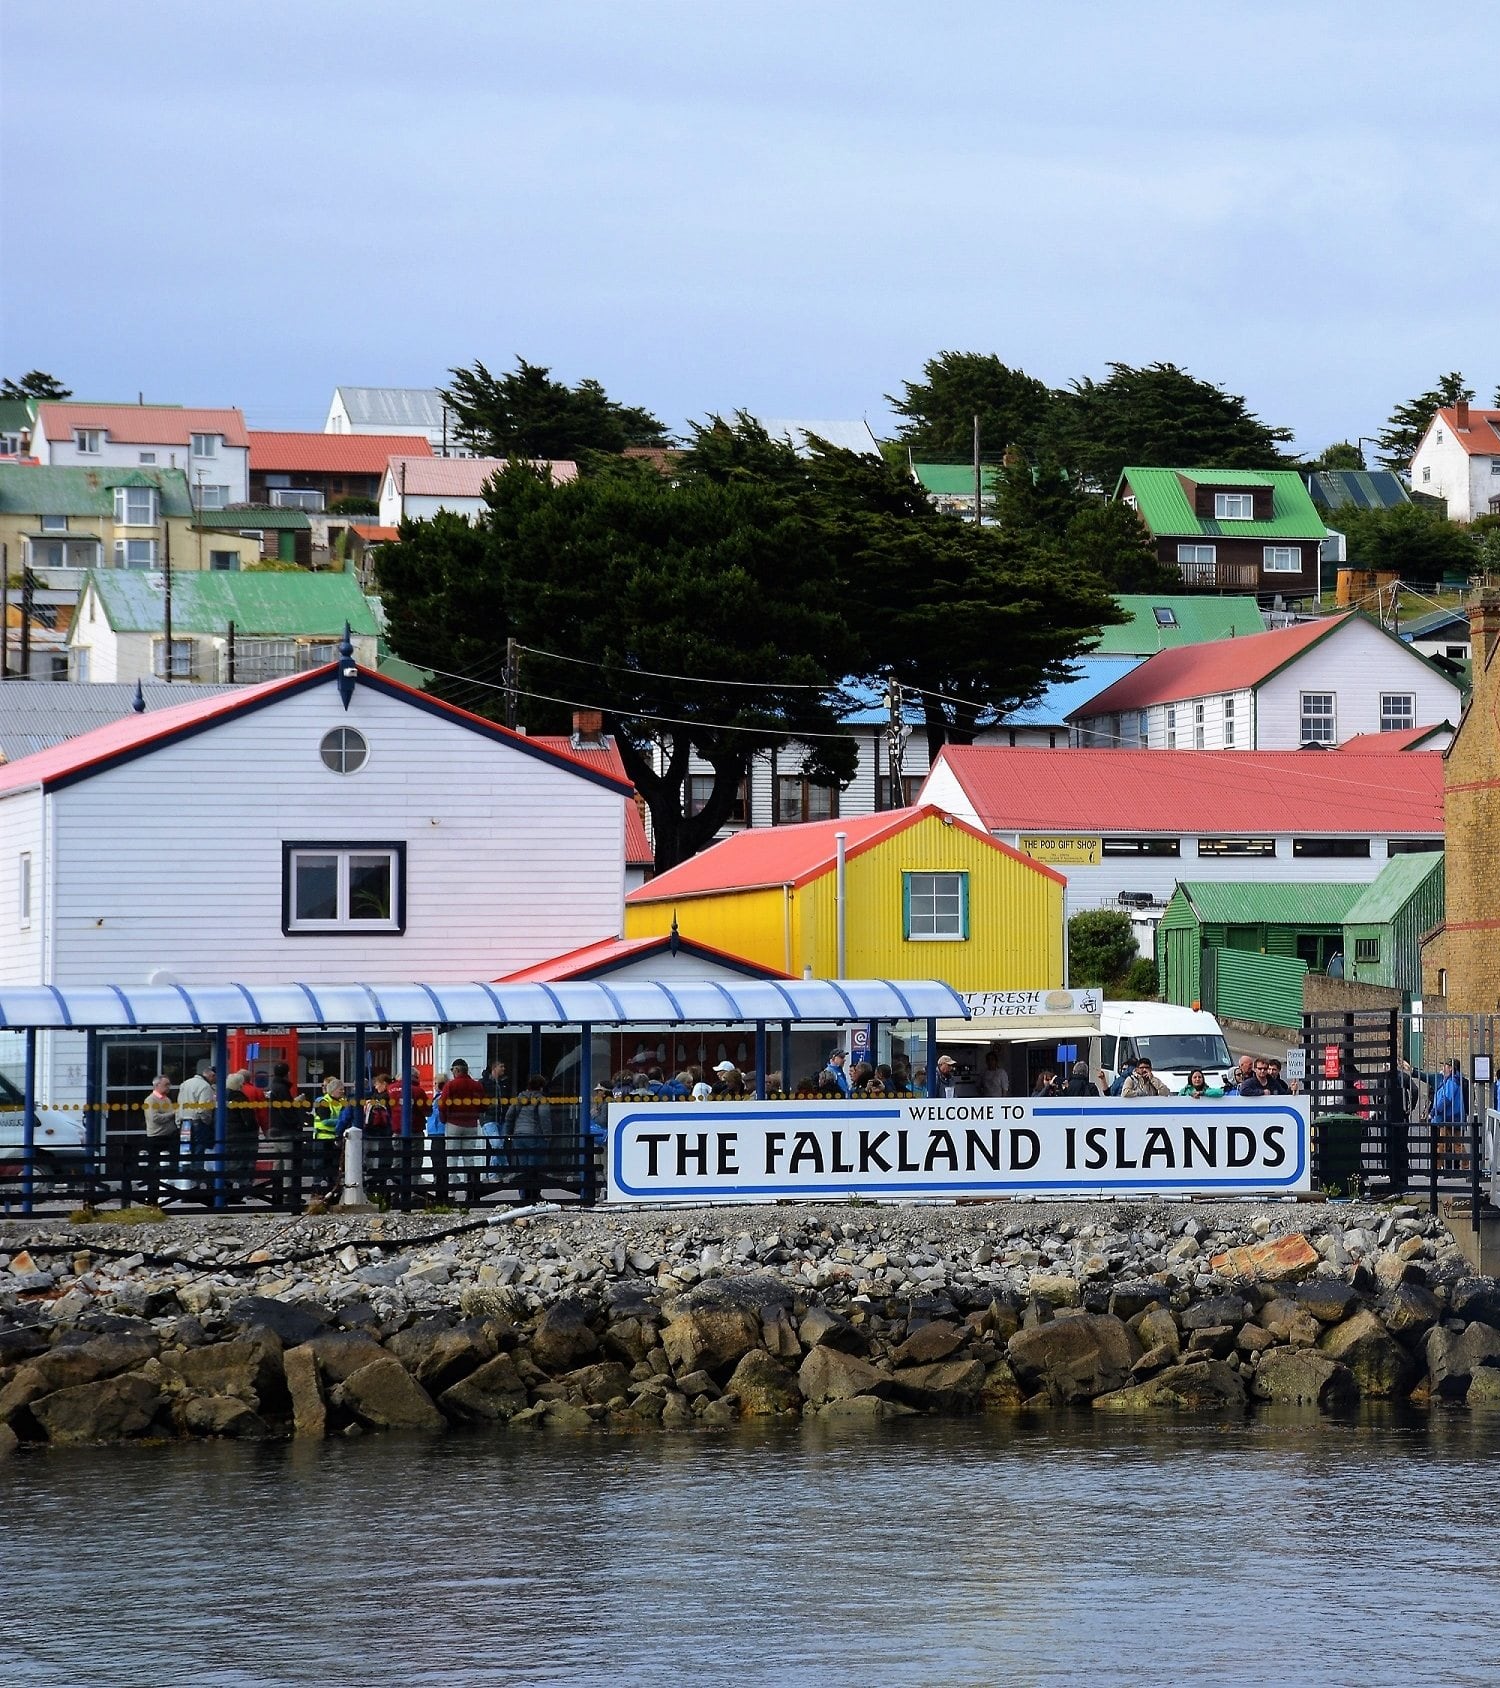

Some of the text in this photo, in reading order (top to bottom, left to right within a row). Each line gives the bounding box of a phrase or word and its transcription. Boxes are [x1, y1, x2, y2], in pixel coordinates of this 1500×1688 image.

[1023, 840, 1097, 850] THE POD GIFT SHOP
[982, 991, 1040, 1006] FRESH
[991, 1005, 1038, 1017] HERE
[1289, 1069, 1303, 1077] Tours
[908, 1105, 1025, 1121] WELCOME TO
[635, 1125, 1286, 1177] THE FALKLAND ISLANDS
